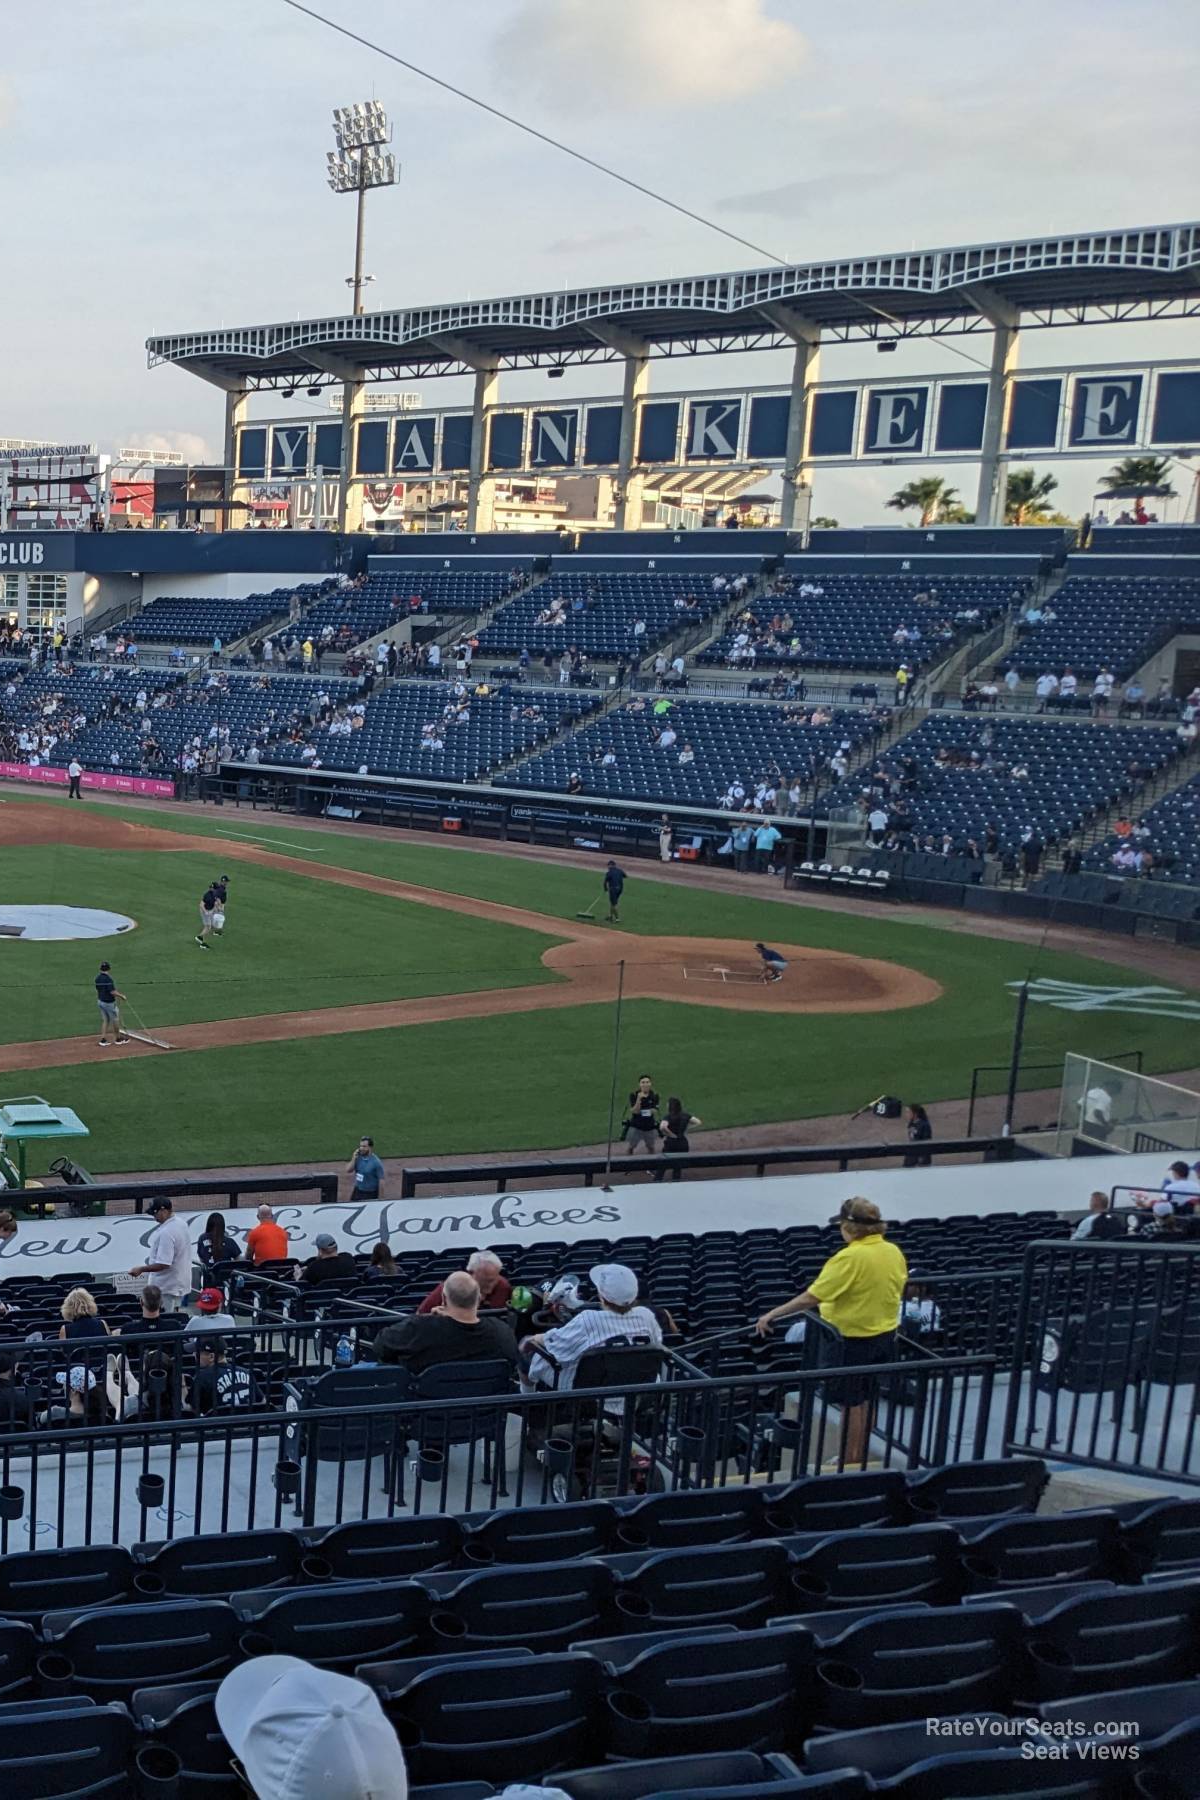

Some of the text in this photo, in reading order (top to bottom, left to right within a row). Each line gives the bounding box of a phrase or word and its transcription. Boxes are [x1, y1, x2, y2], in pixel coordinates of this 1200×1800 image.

[28, 447, 55, 457] JAMES
[56, 444, 91, 456] STADIUM
[313, 1196, 622, 1253] Yankees
